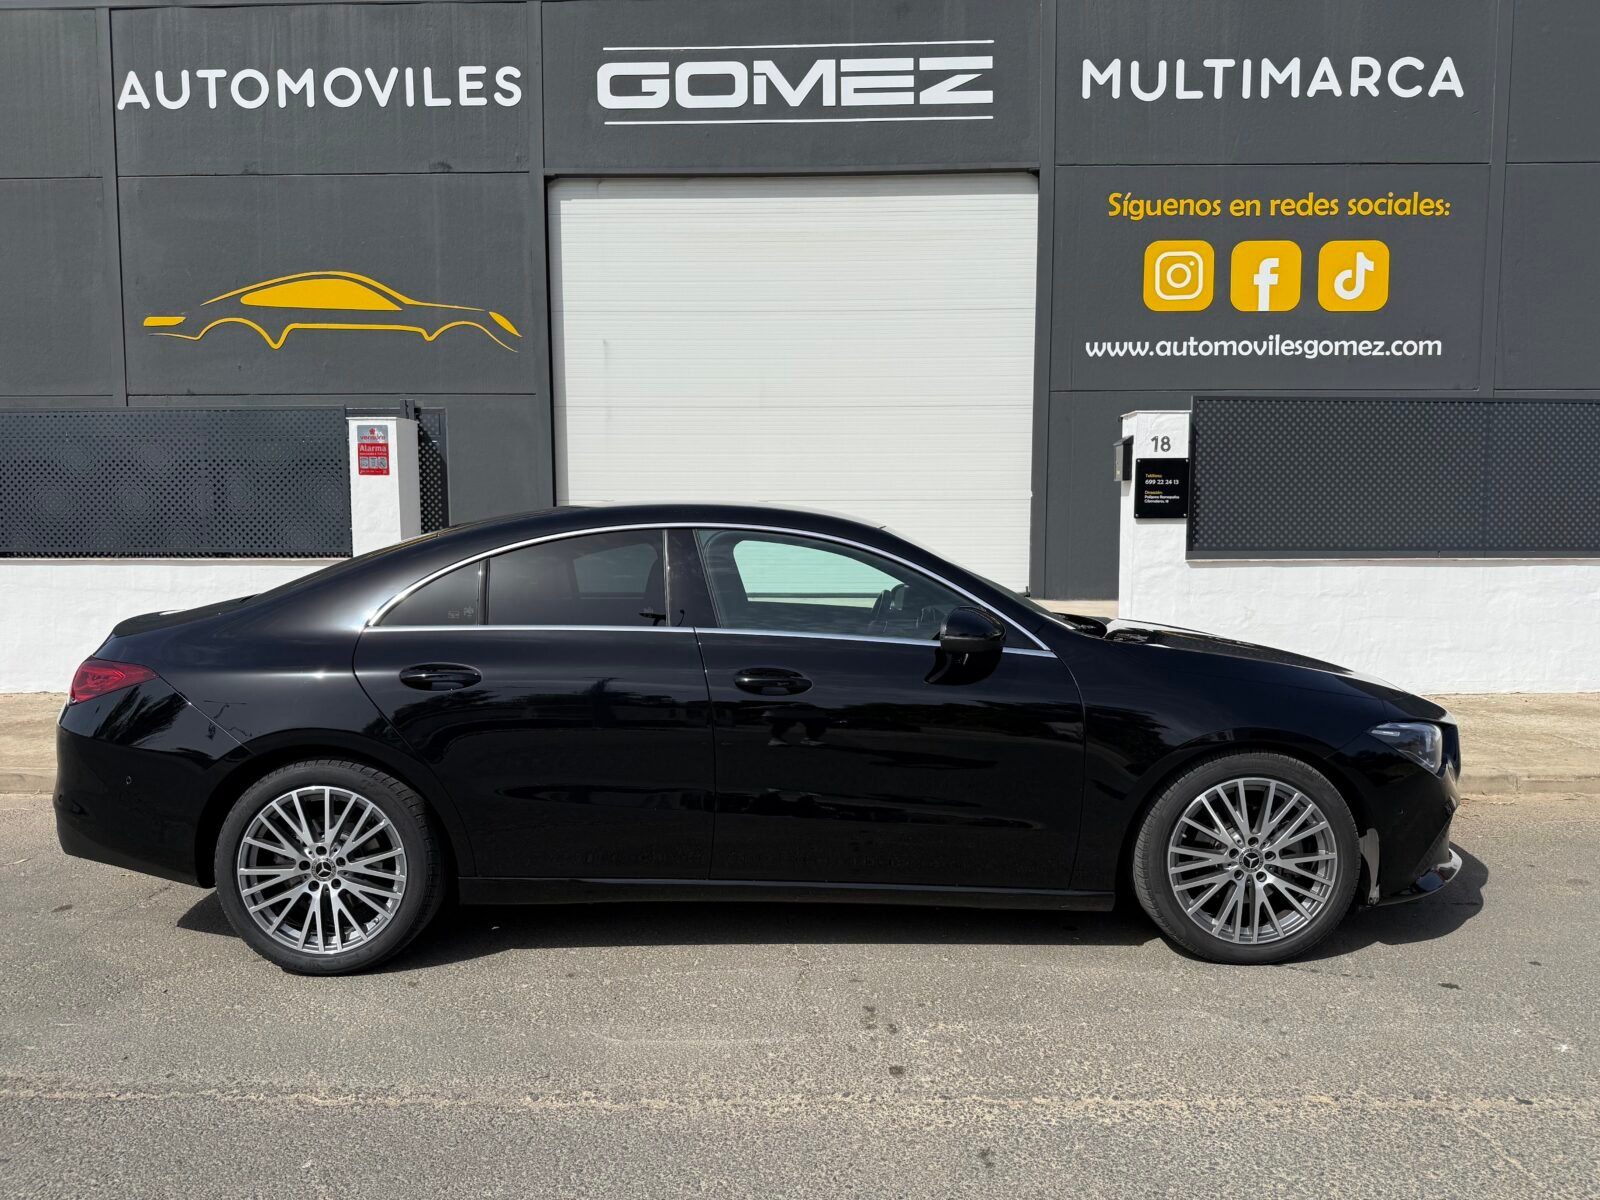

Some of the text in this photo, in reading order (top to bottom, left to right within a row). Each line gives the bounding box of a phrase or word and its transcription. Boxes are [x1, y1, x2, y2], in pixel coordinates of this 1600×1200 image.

[117, 65, 522, 111] AUTOMOVILES
[596, 55, 994, 110] GOMEZ
[1081, 56, 1465, 102] MULTIMARCA
[1108, 191, 1451, 221] Síguenos en redes sociales:
[1085, 333, 1442, 360] www.automovilesgomez.com
[359, 444, 387, 452] Alarma
[1150, 435, 1172, 453] 18
